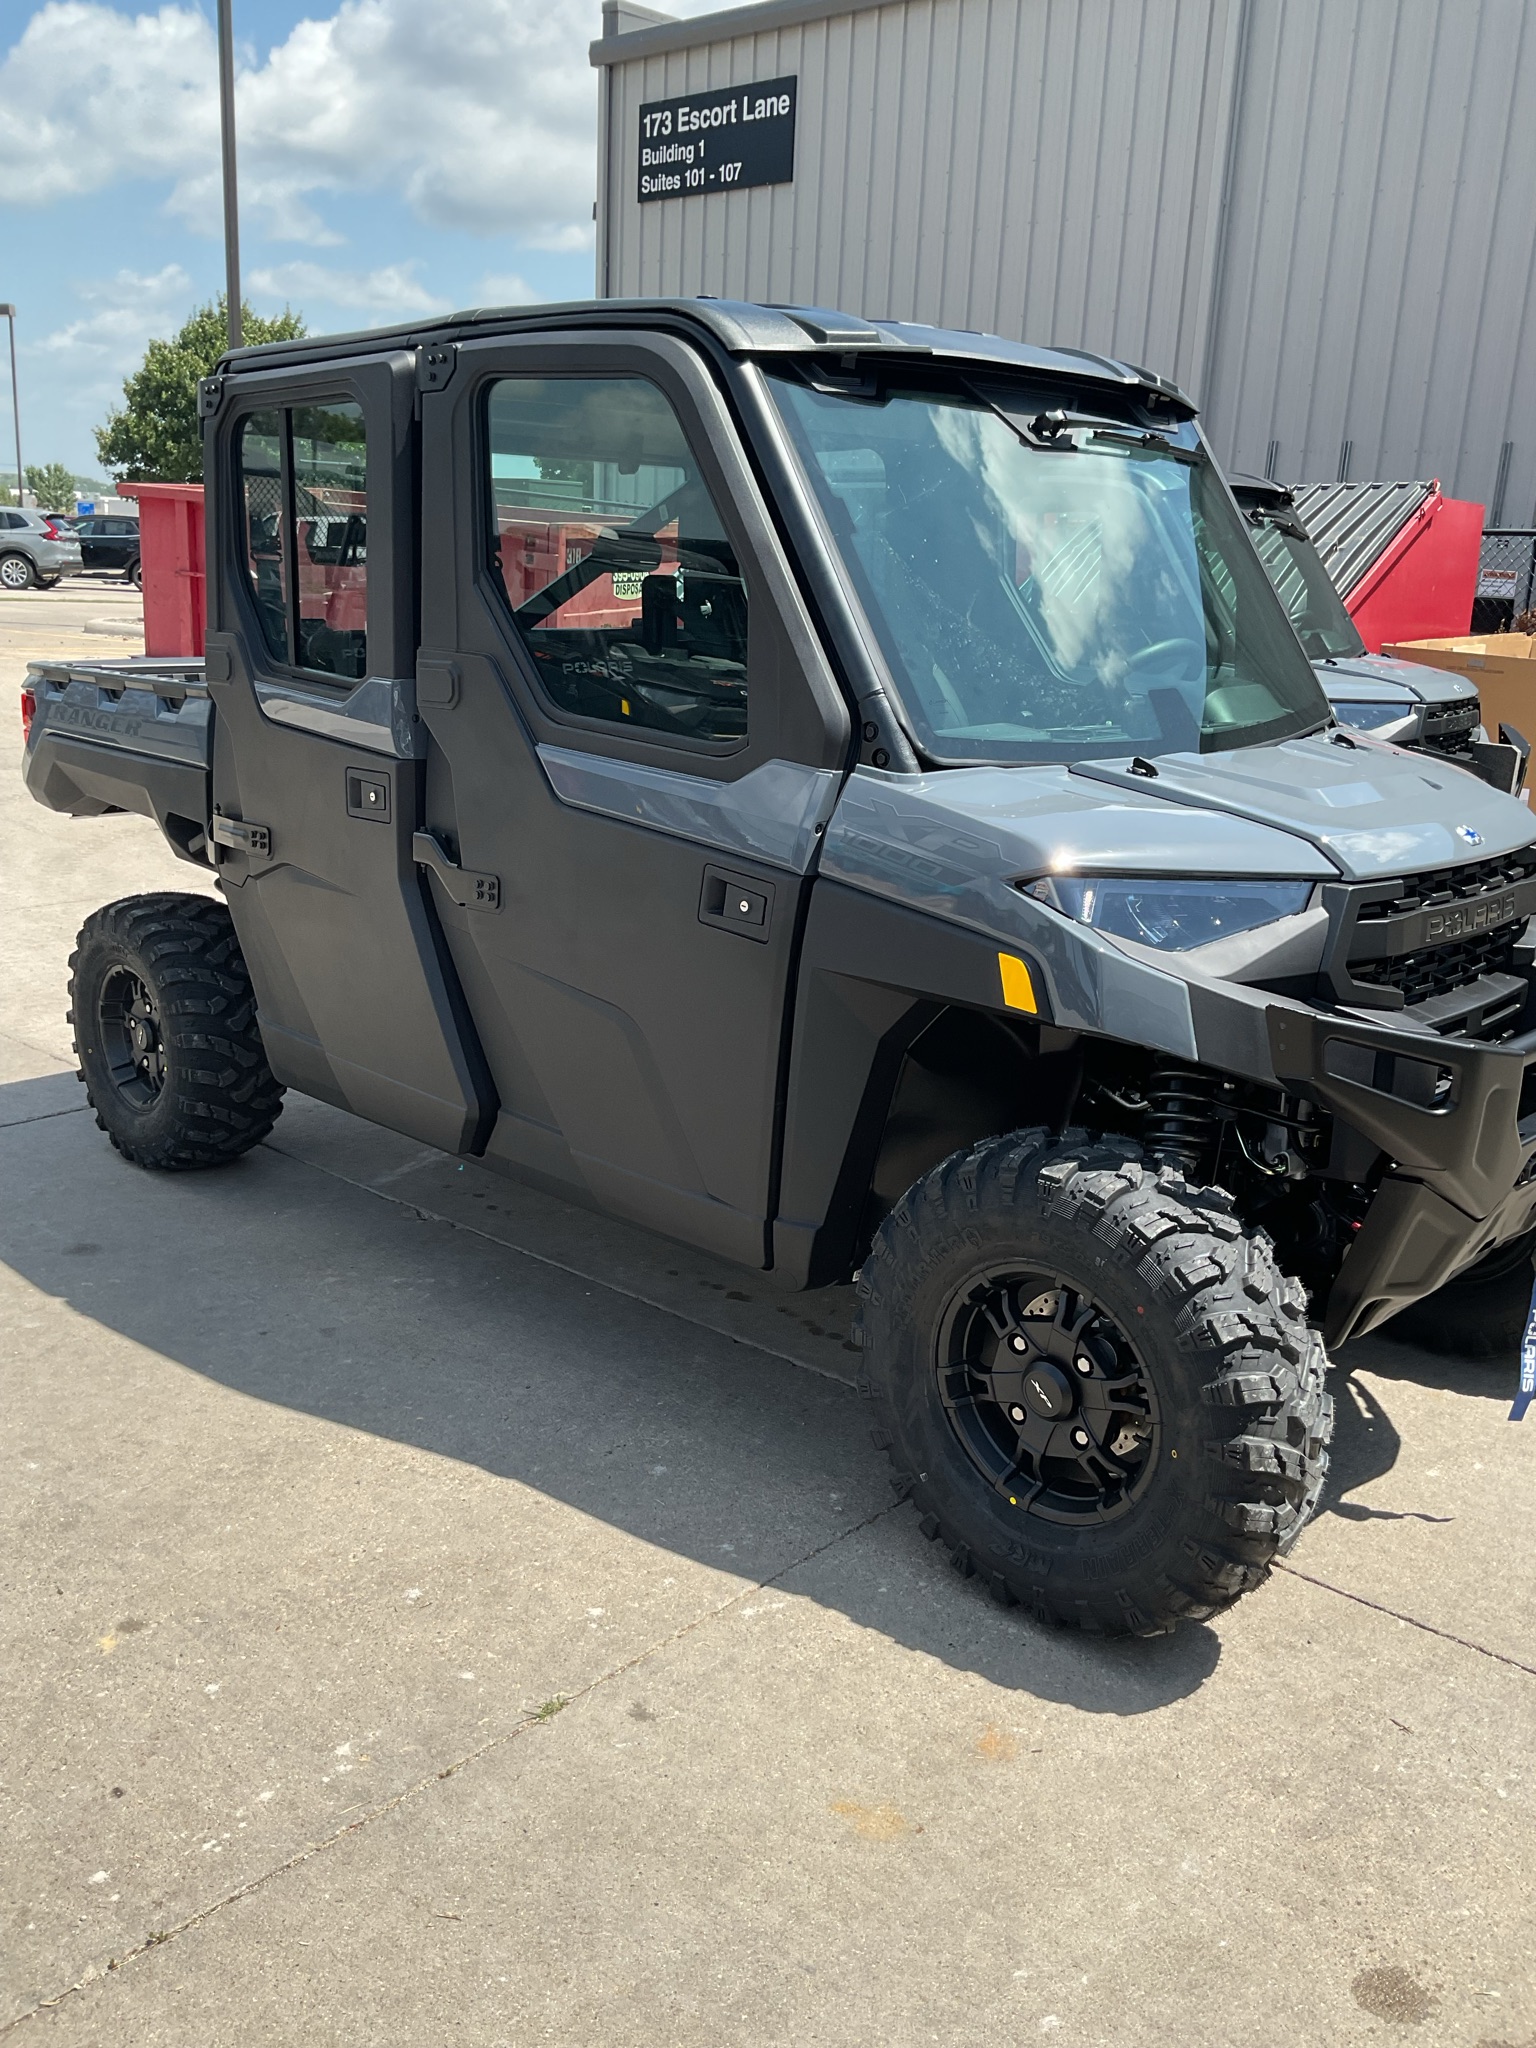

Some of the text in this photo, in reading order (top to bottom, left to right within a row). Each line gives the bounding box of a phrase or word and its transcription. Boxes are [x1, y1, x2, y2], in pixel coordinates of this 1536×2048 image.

[643, 94, 790, 138] 173 Escort Lane
[642, 139, 705, 166] Building 1
[641, 174, 681, 194] Suites
[684, 168, 705, 187] 101
[719, 162, 742, 182] 107
[49, 703, 142, 737] RANGER
[839, 828, 943, 878] 1000
[1425, 892, 1516, 942] POLARIS
